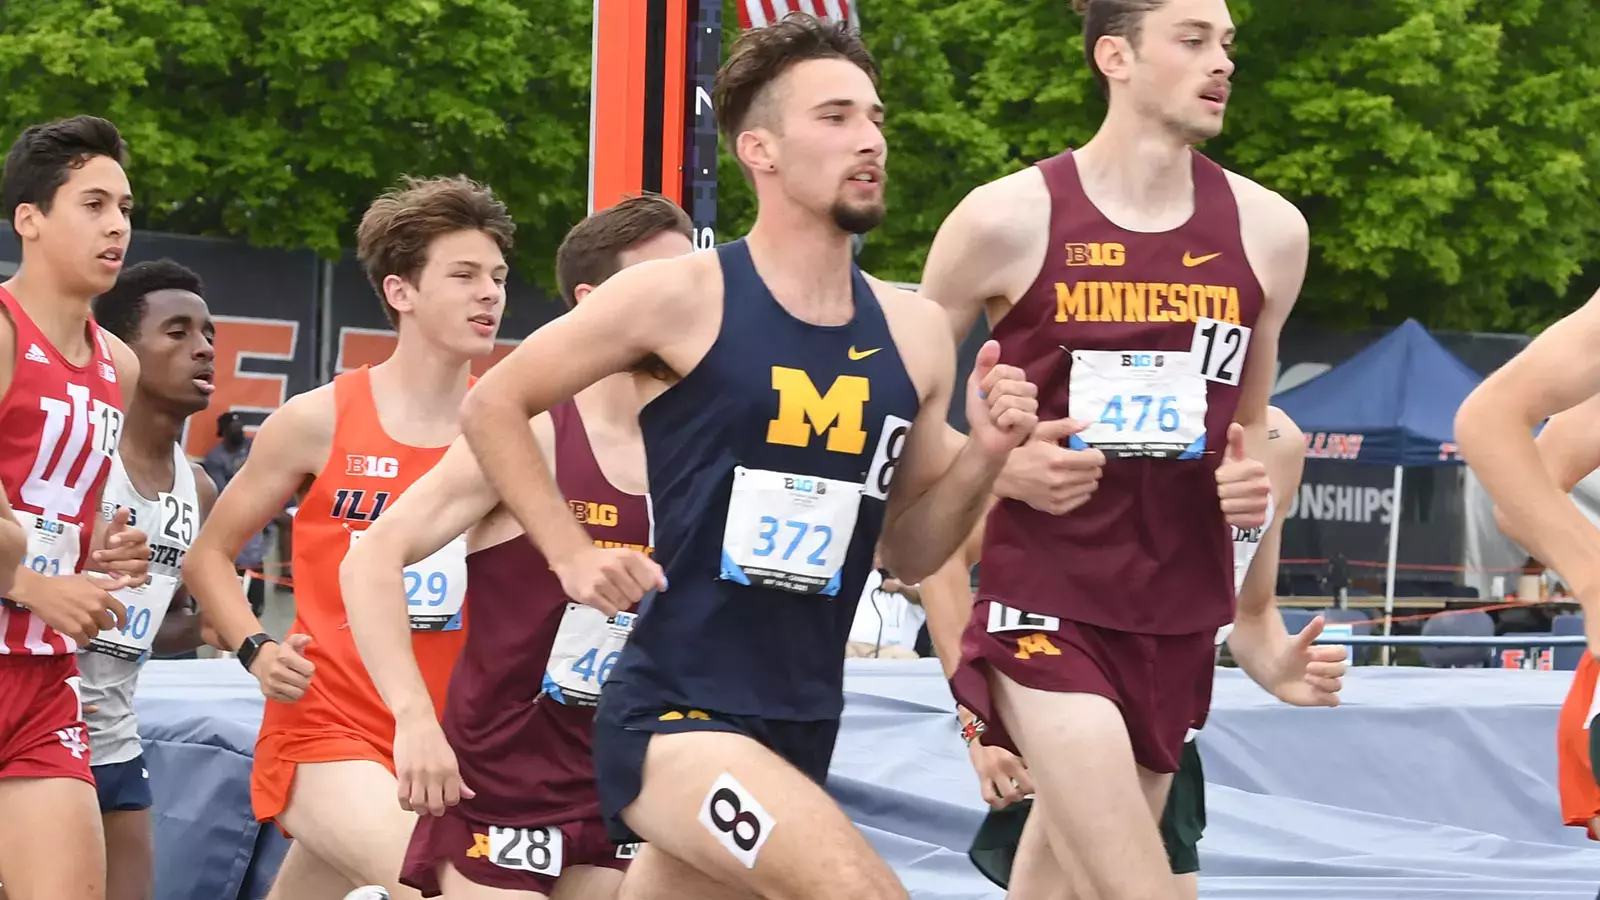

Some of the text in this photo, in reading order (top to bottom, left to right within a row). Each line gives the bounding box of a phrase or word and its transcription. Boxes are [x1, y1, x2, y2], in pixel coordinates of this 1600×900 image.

[1054, 281, 1242, 326] MINNESOTA
[1201, 323, 1242, 381] 12
[101, 408, 120, 456] 13
[766, 365, 871, 455] M
[1100, 395, 1180, 432] 476
[164, 495, 193, 546] 25
[752, 516, 834, 567] 372
[710, 787, 761, 852] 8
[496, 827, 551, 870] 28
